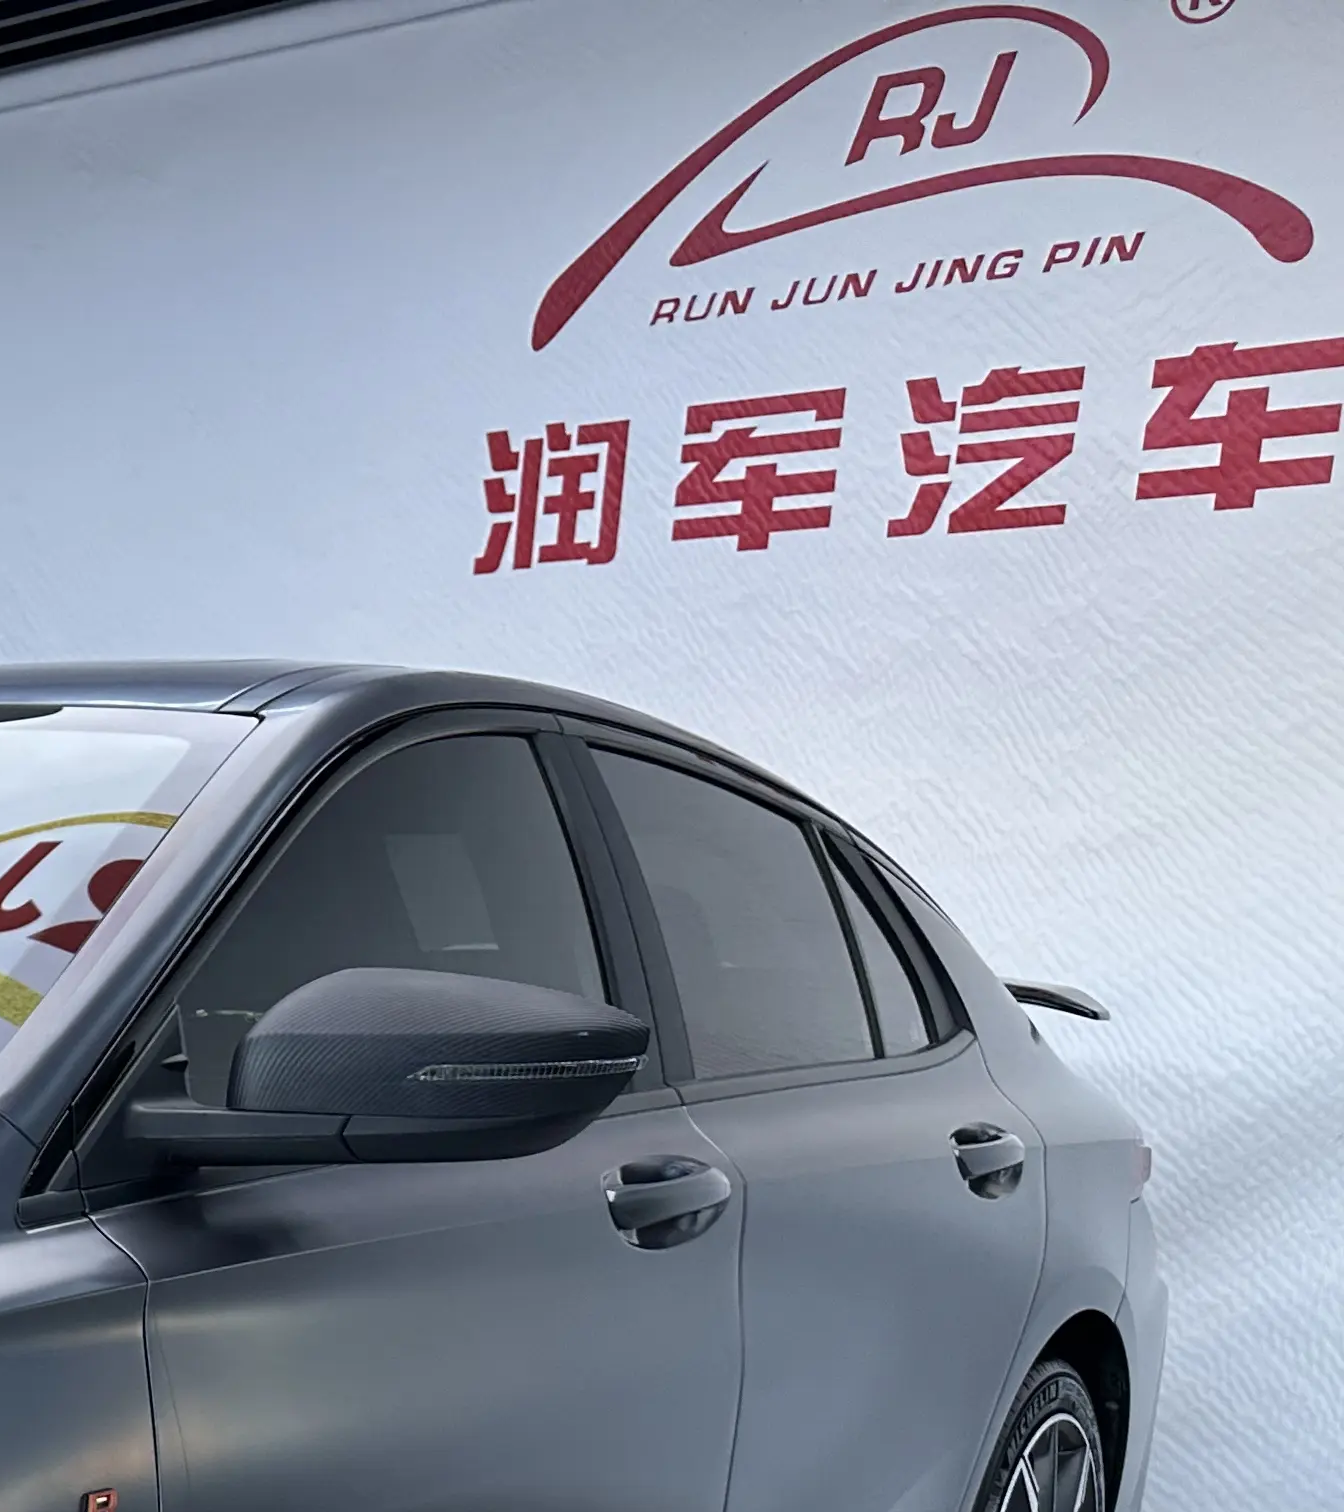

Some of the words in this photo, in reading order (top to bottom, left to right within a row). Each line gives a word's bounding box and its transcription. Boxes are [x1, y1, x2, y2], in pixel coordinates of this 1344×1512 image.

[845, 51, 1018, 166] RJ
[650, 287, 755, 325] RUN
[770, 269, 878, 311] JUN
[894, 249, 1024, 294] JING
[1042, 231, 1146, 274] PIN
[474, 337, 1344, 575] 润军汽车
